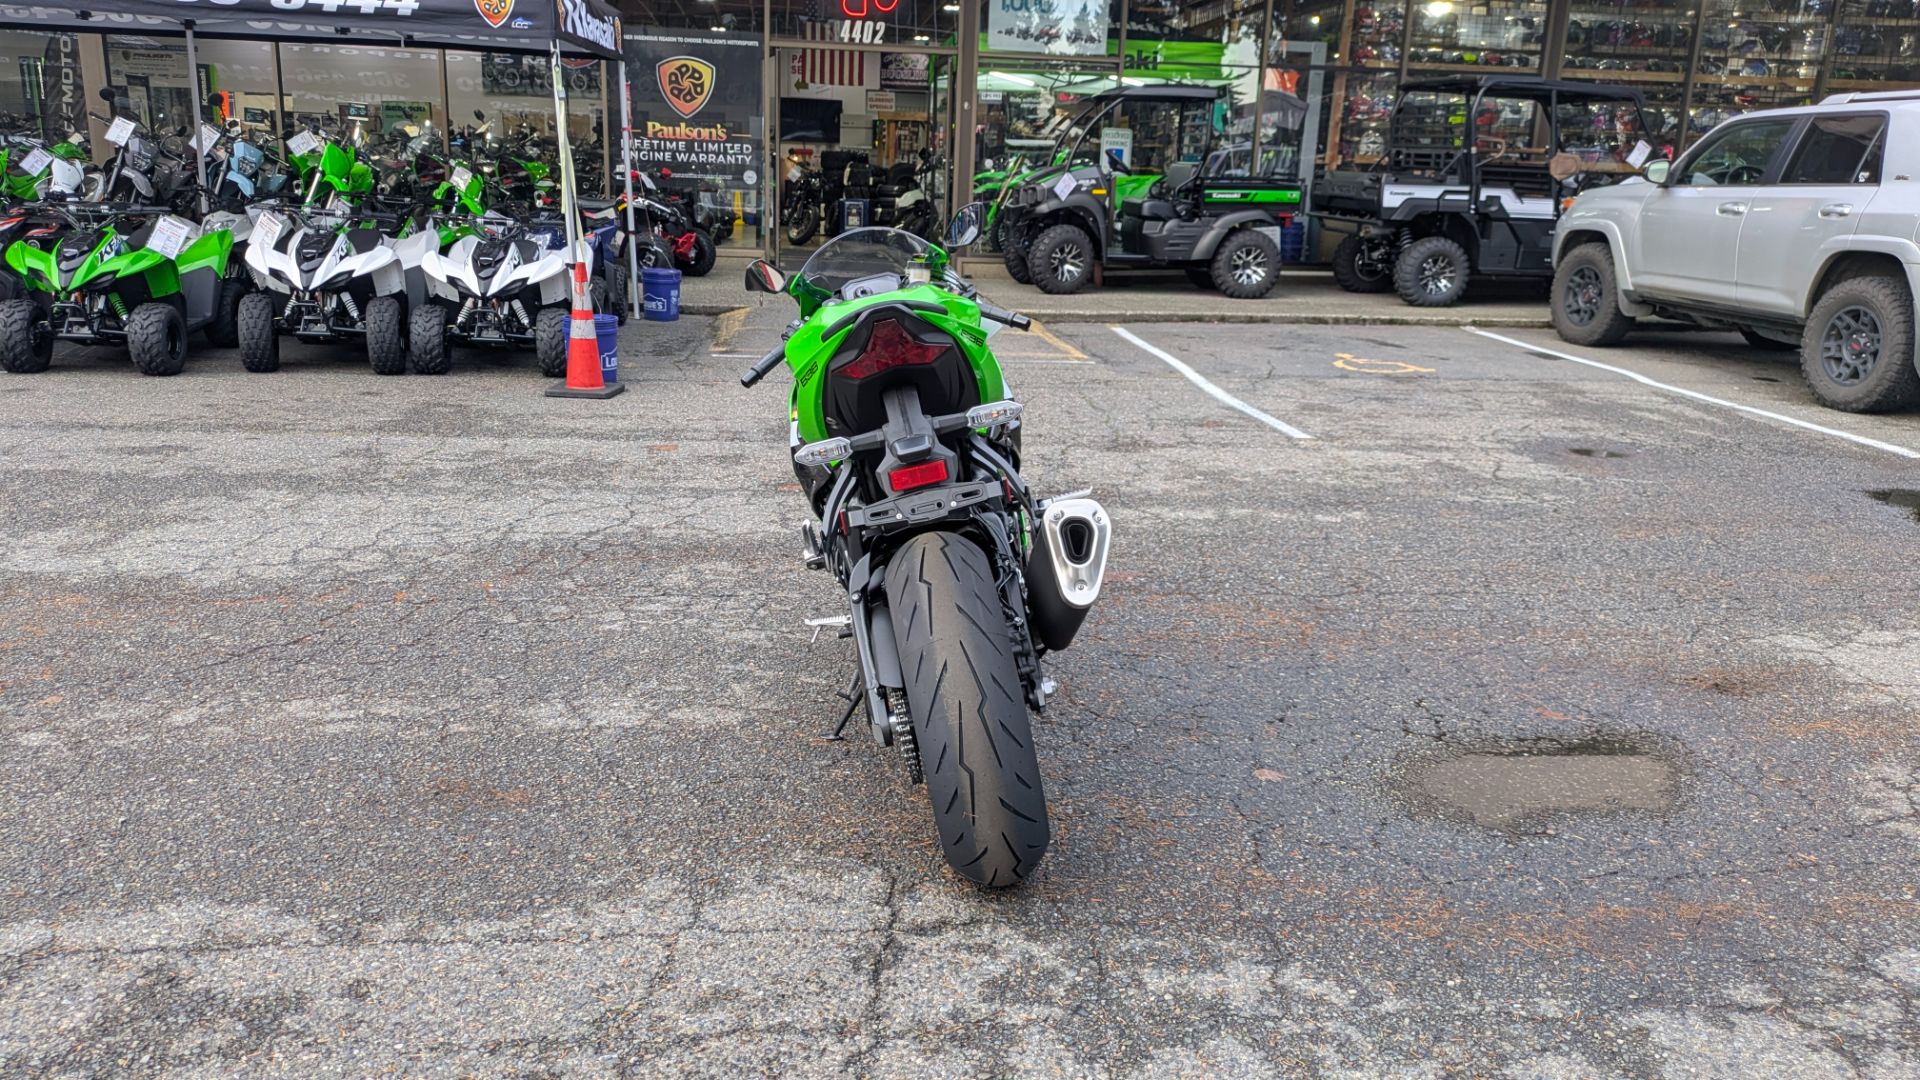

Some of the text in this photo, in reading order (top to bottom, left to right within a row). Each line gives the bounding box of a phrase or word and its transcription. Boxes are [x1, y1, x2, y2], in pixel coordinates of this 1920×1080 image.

[840, 19, 886, 44] 4402
[59, 34, 75, 133] CFMOTO
[646, 121, 728, 141] Paulson's
[694, 141, 753, 154] LIMITED
[676, 152, 753, 164] WARRANTY
[961, 328, 985, 347] 636
[800, 360, 818, 388] 636
